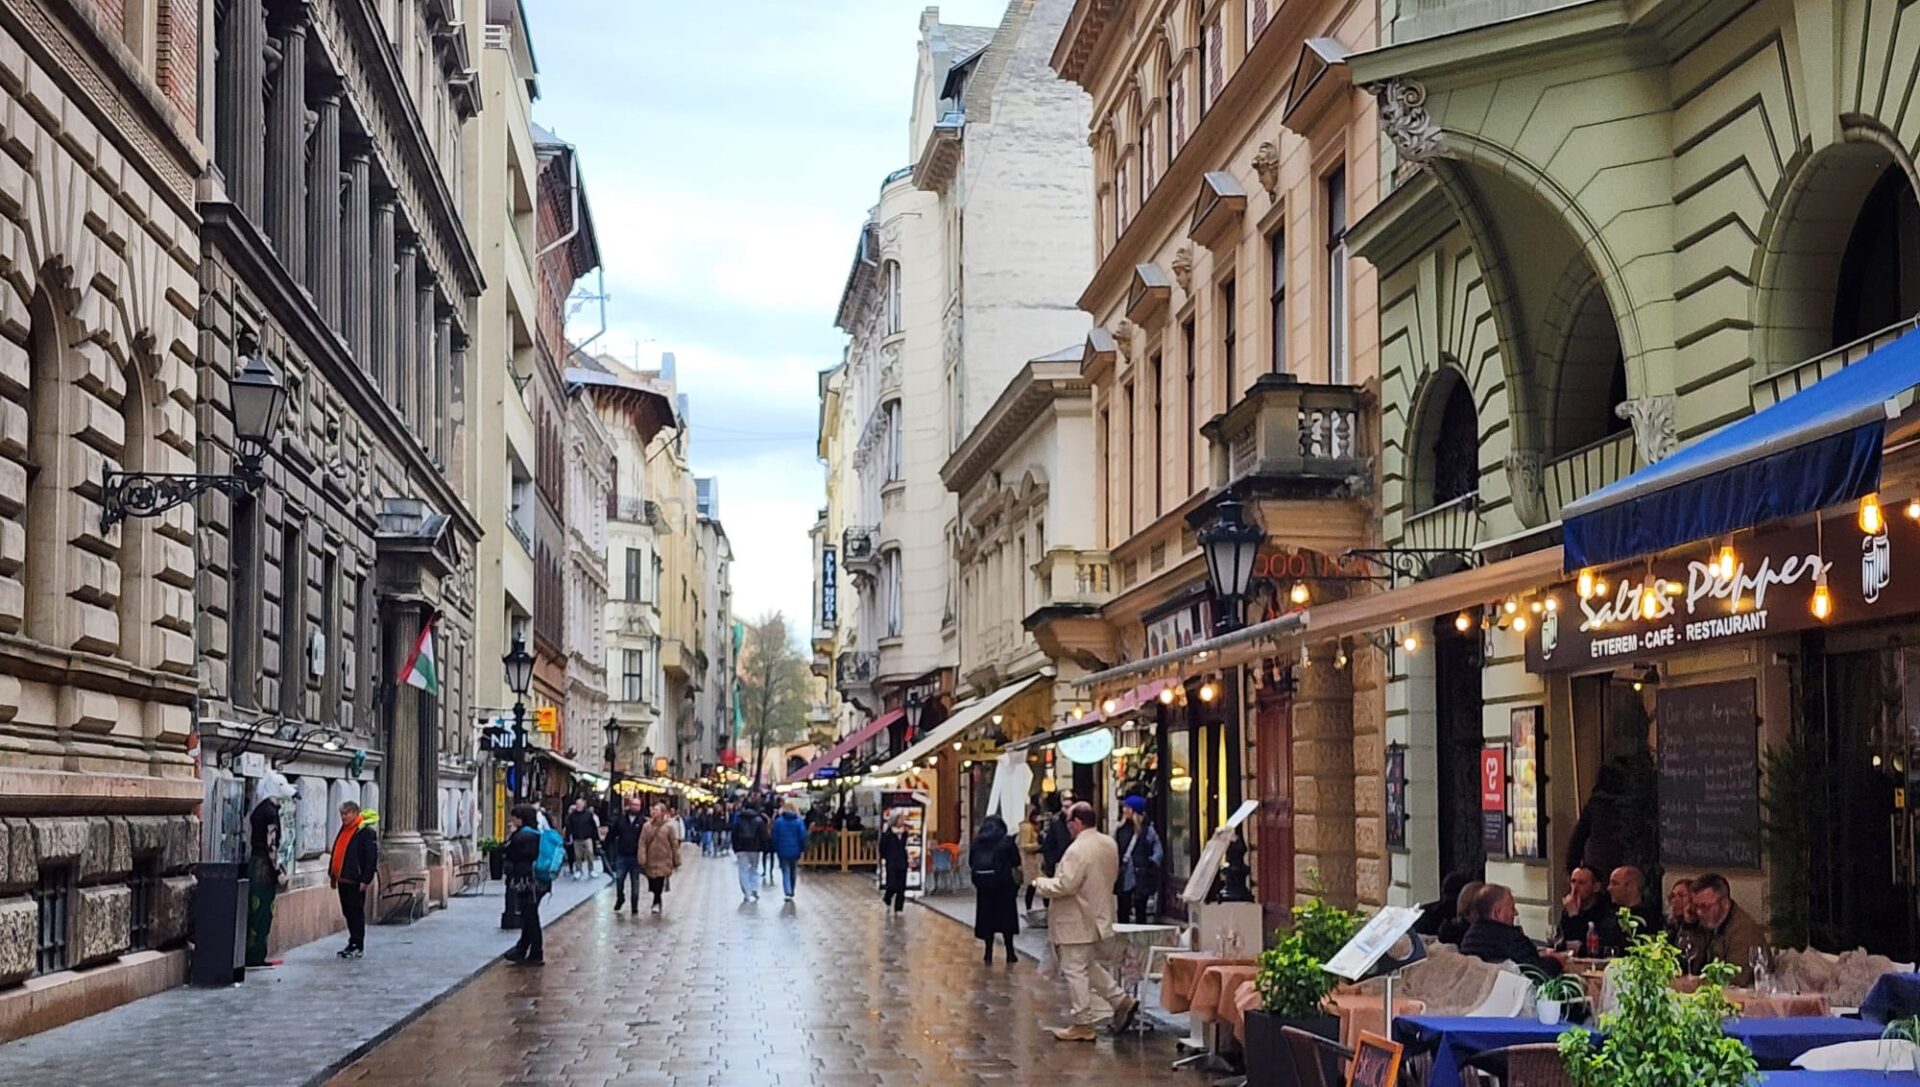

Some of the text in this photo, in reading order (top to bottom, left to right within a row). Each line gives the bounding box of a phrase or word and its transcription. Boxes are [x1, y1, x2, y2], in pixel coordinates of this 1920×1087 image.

[1579, 554, 1833, 632] Salt & Pepper
[1591, 610, 1768, 658] ÉTTEREM CAFÉ RESTAURANT
